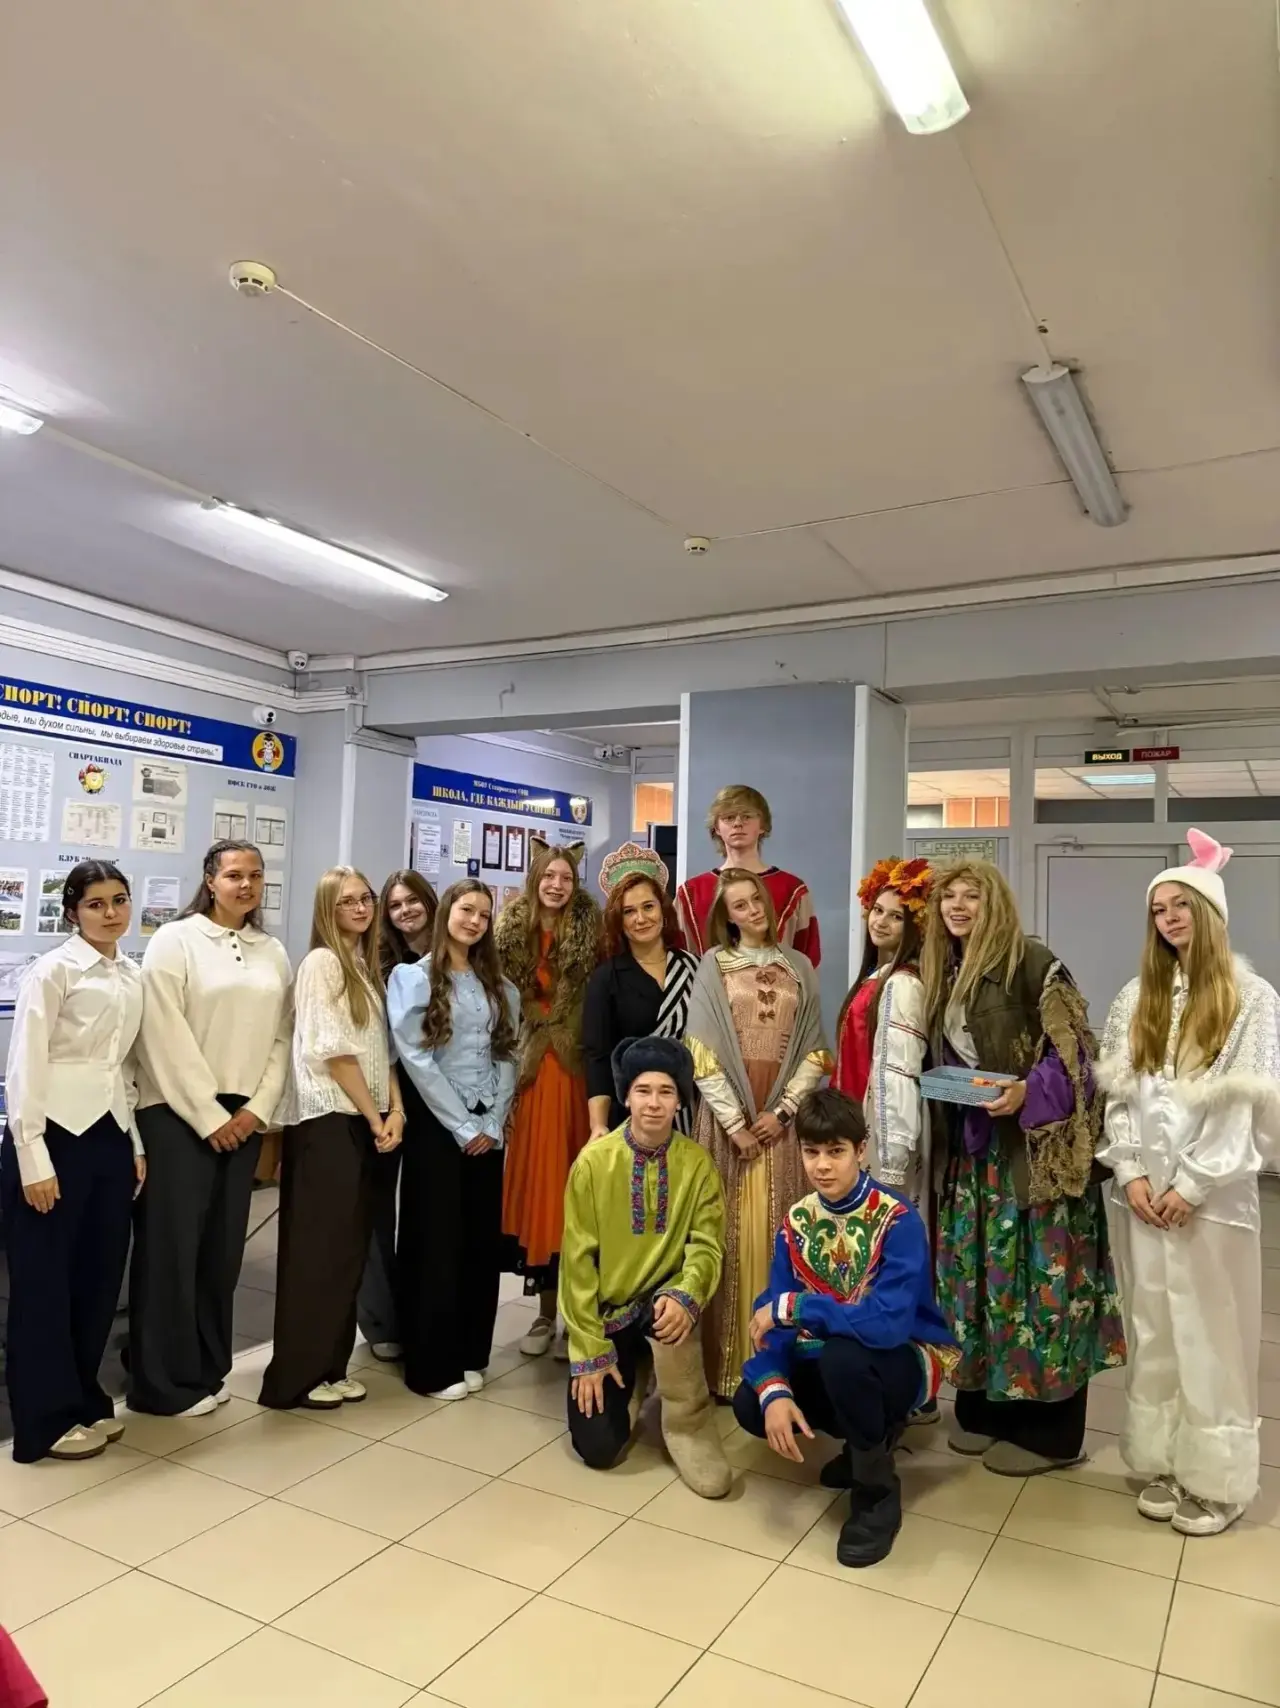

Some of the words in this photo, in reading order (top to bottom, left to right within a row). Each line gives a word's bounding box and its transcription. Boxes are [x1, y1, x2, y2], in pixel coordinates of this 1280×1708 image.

[67, 698, 130, 723] СПОРТ!
[134, 711, 192, 735] СПОРТ!
[23, 716, 37, 726] мы
[39, 717, 64, 731] духом
[115, 731, 153, 748] выбираем
[1141, 750, 1172, 759] ПОЖАР
[432, 786, 469, 802] ШКОЛА,
[470, 793, 486, 805] ГДЕ
